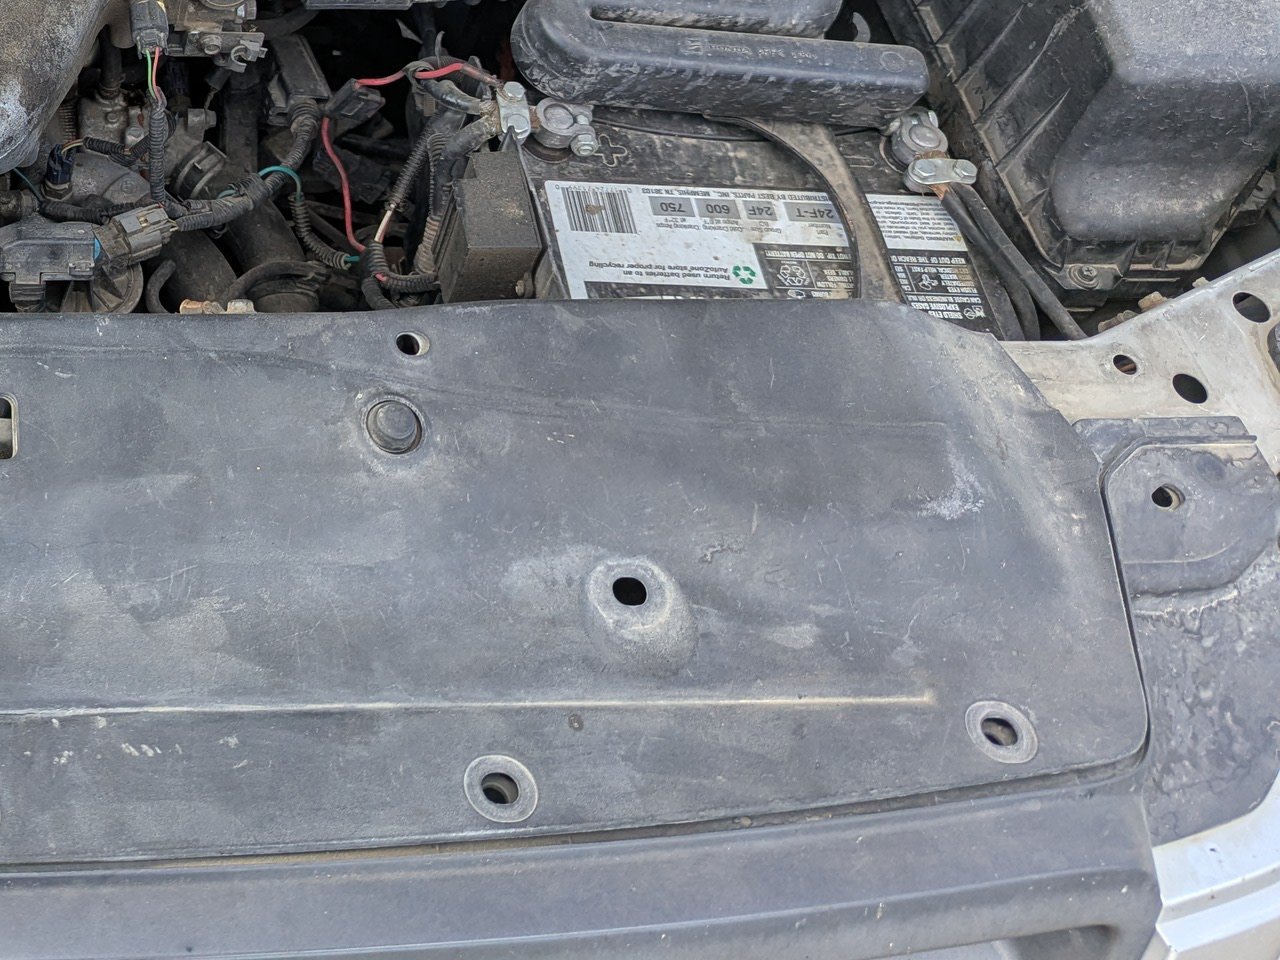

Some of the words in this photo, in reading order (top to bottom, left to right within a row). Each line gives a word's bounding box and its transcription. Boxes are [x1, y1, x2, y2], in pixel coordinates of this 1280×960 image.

[660, 202, 686, 213] 750
[705, 204, 729, 214] 600
[748, 206, 772, 216] 24F
[796, 208, 833, 219] 24F-T
